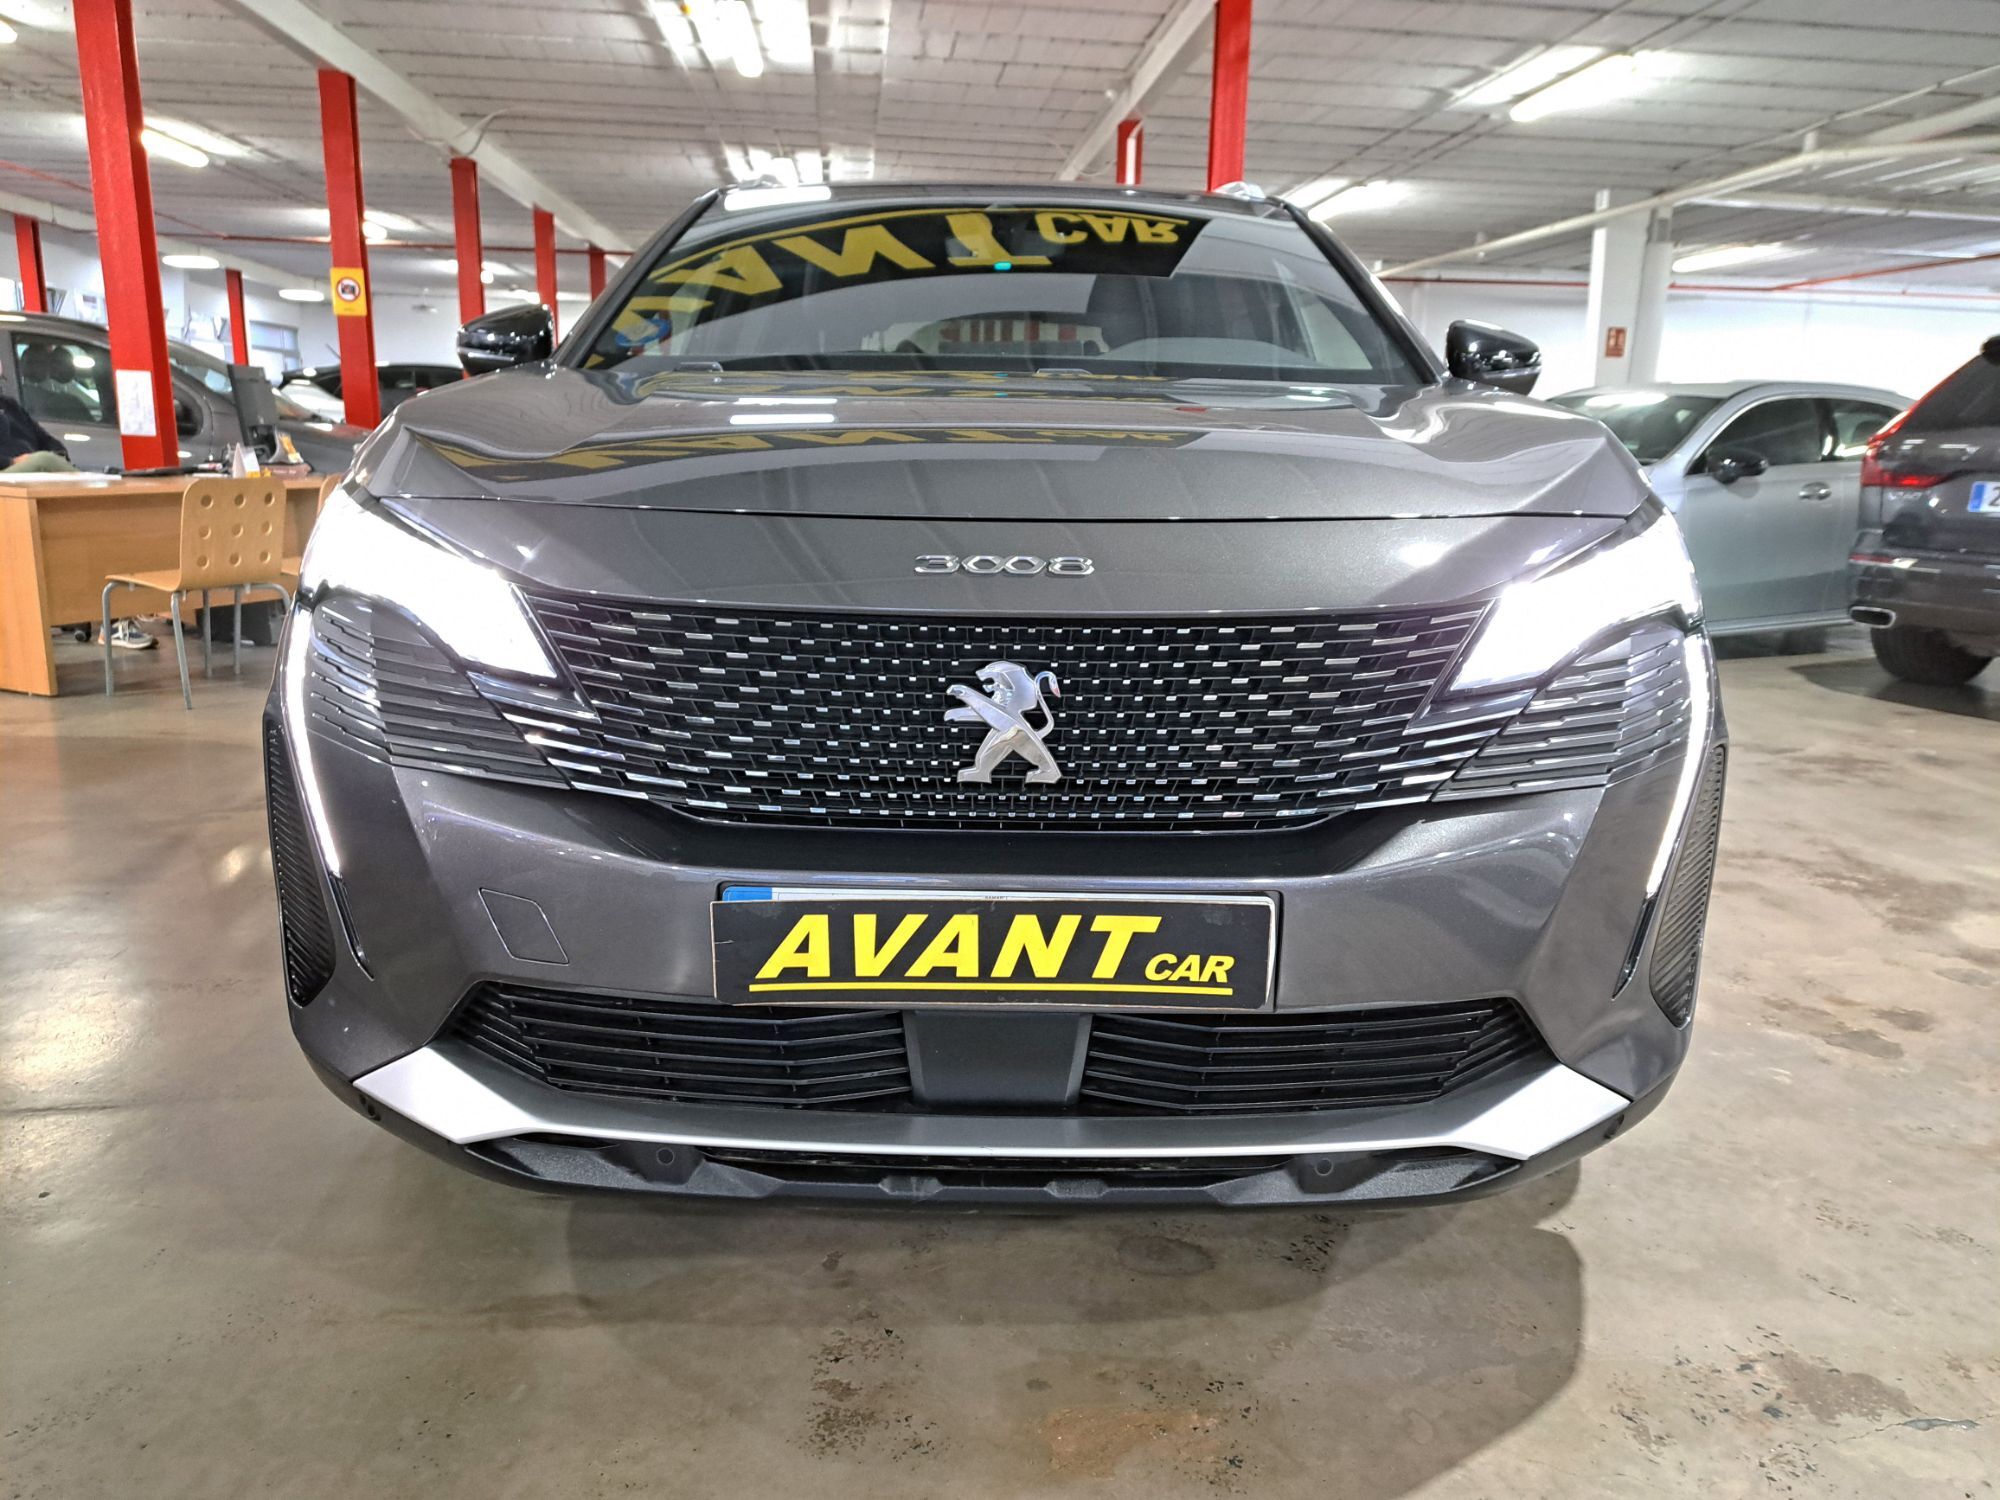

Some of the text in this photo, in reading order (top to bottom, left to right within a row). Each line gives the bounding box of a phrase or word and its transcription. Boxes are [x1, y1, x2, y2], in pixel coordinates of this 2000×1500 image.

[914, 554, 1095, 576] 3008
[755, 913, 1235, 983] AVANT CAR
